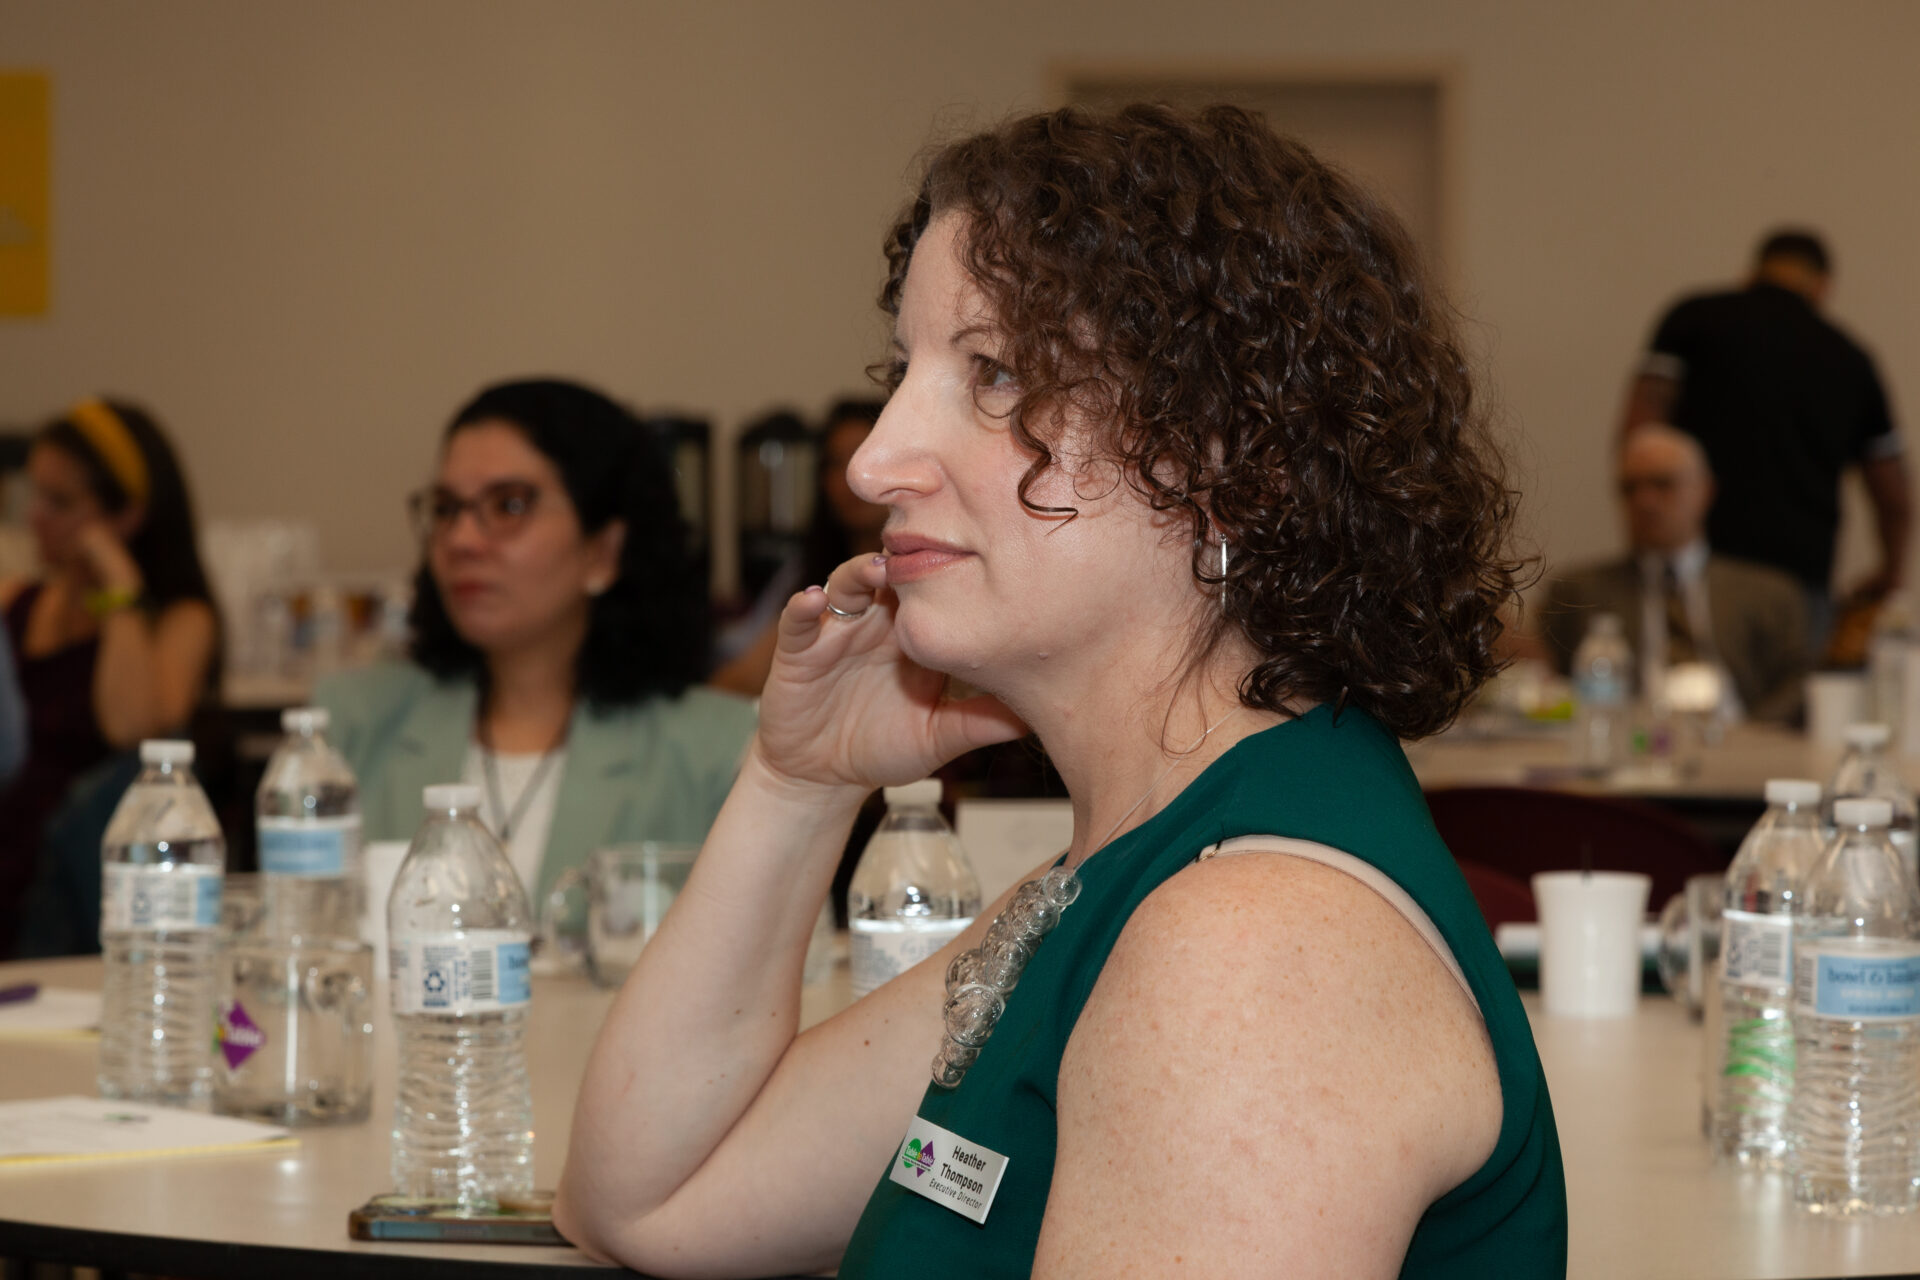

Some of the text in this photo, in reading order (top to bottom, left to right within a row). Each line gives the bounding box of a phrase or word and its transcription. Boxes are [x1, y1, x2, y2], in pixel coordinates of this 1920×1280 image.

[952, 1145, 987, 1172] Heather
[929, 1178, 983, 1209] Executive Director
[940, 1163, 984, 1195] Thompson
